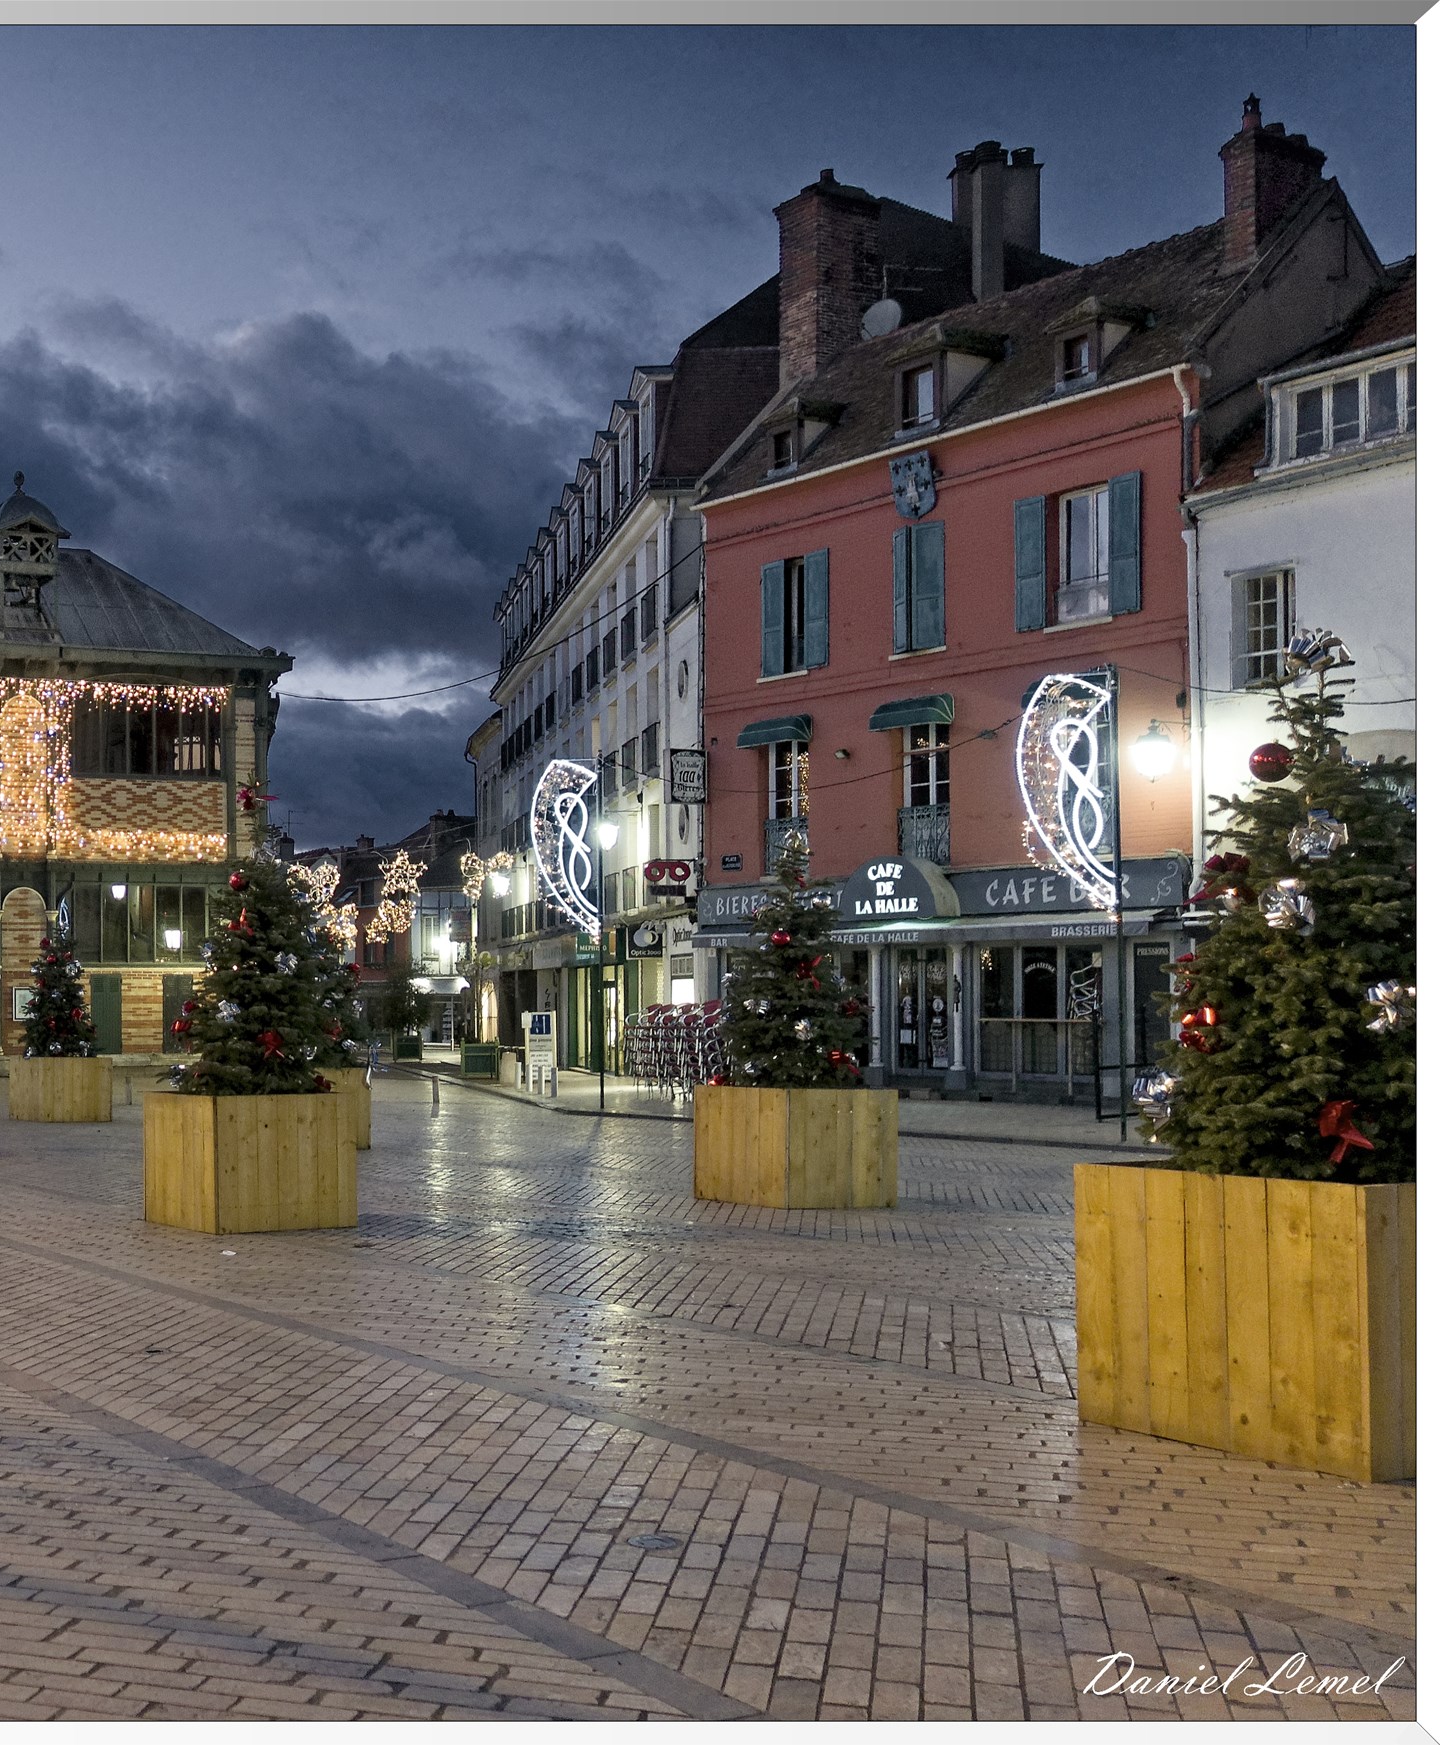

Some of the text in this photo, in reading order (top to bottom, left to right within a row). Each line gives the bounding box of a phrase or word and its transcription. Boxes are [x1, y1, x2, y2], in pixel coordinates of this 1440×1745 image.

[679, 770, 696, 783] 100
[867, 863, 903, 881] CAFE
[876, 881, 895, 896] DE
[985, 875, 1057, 907] CAFE
[855, 900, 873, 915] LA
[875, 897, 919, 914] HALLE
[1051, 923, 1117, 937] BRASSERIE
[711, 938, 728, 947] BAR
[857, 933, 869, 943] DE
[872, 933, 884, 943] LA
[887, 932, 919, 942] HALLE
